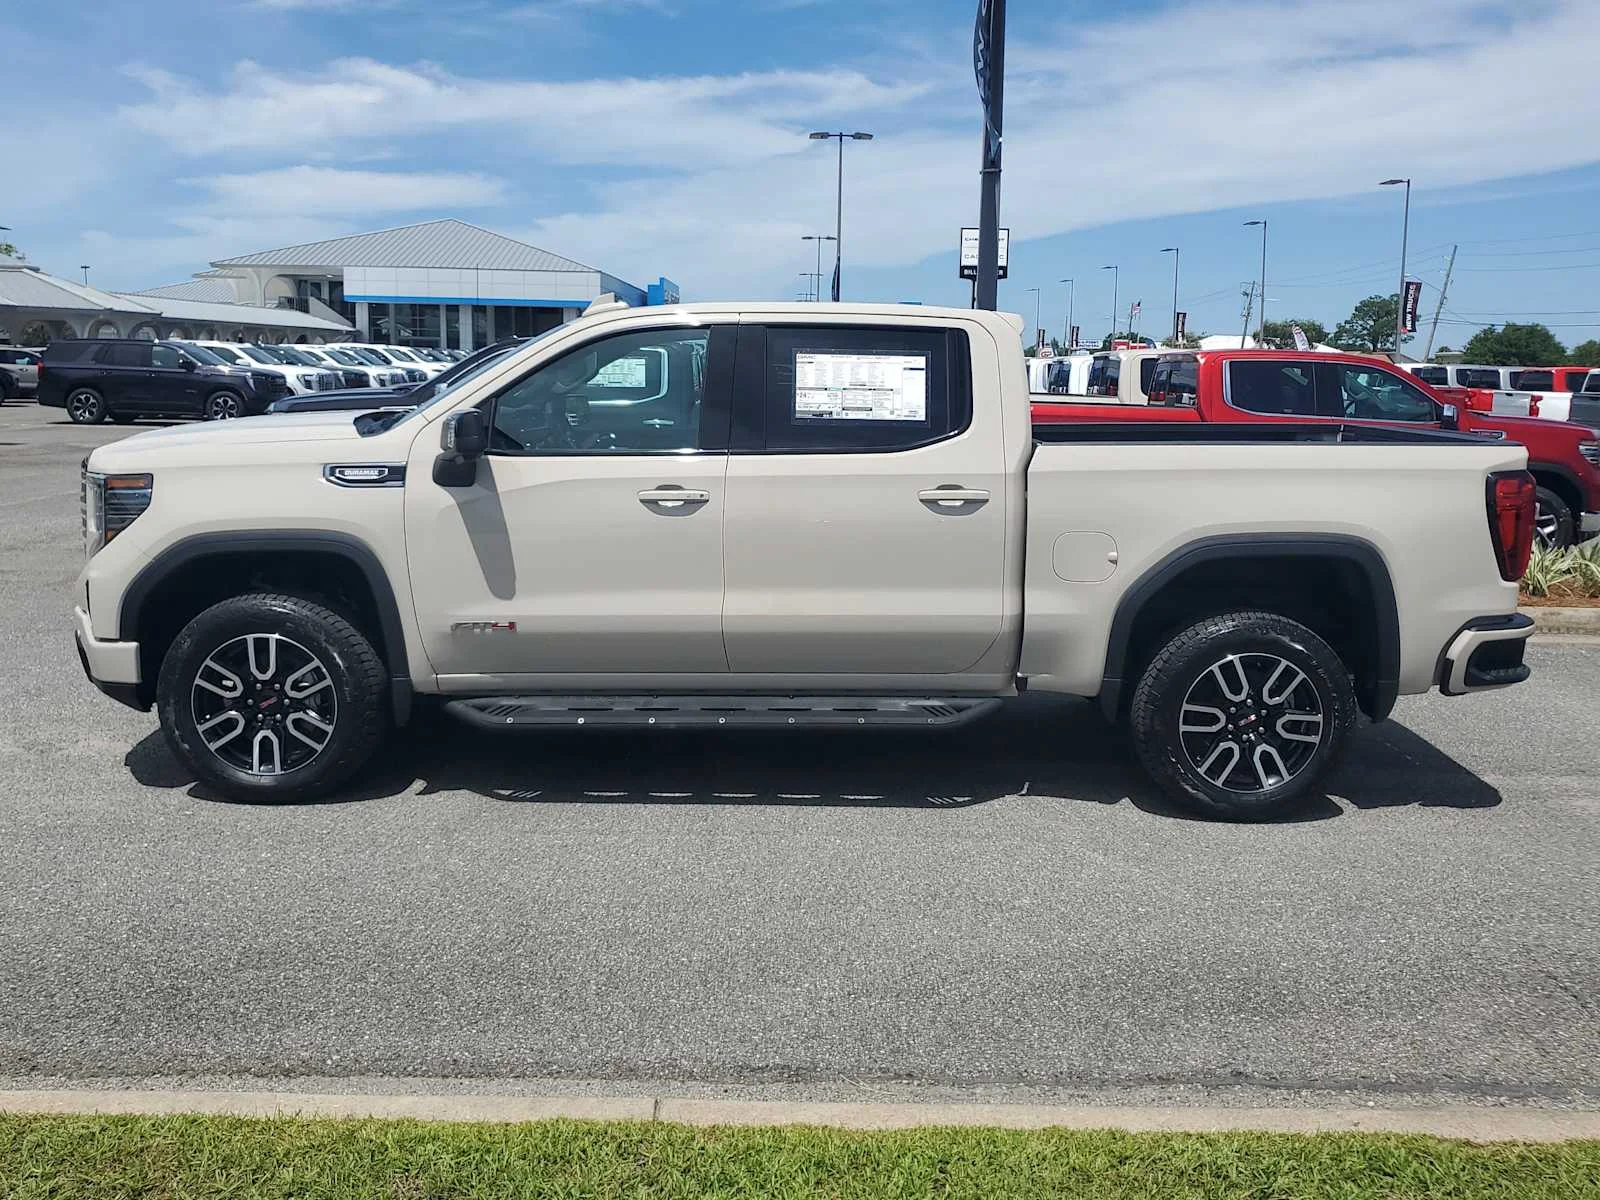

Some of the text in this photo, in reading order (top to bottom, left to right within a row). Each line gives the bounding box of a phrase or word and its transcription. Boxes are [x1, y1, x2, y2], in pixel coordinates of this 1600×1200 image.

[1405, 284, 1417, 331] NEW TRUCKS
[344, 469, 380, 477] DURAMAX
